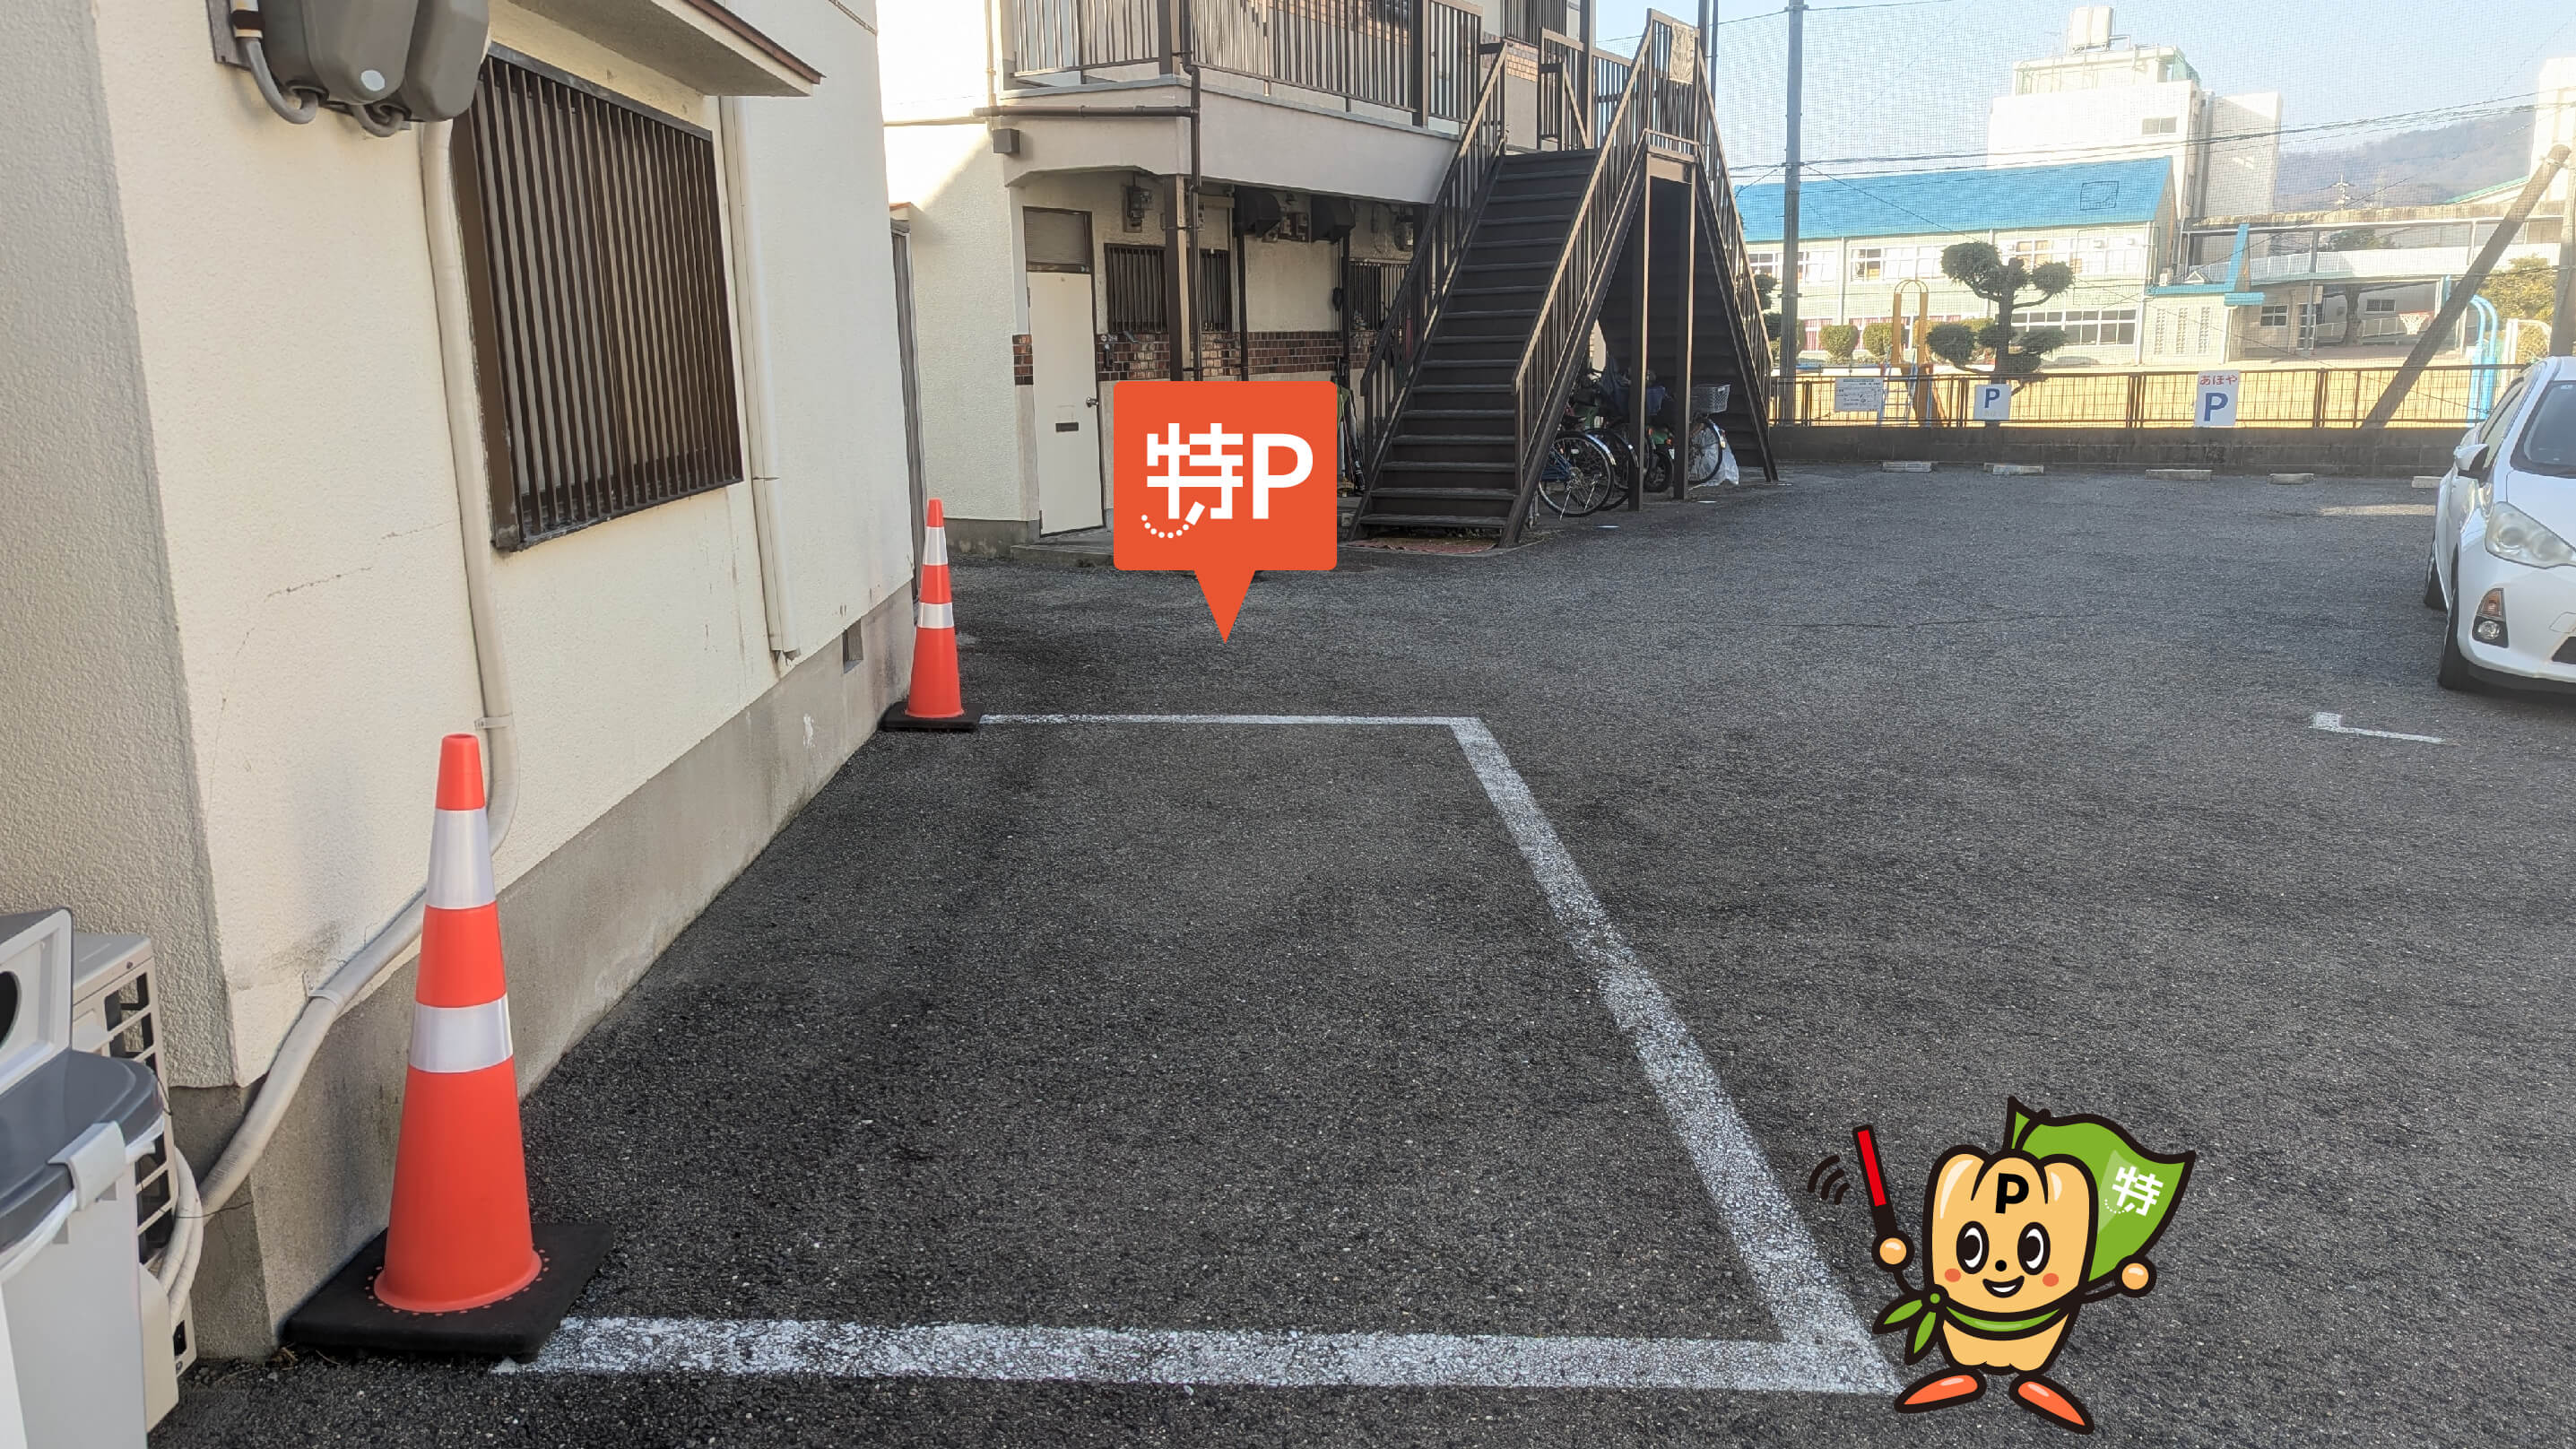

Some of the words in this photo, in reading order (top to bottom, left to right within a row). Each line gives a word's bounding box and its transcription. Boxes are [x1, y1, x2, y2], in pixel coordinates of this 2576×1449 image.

[2199, 375, 2237, 385] あほや
[1984, 388, 1999, 408] P
[2204, 393, 2228, 421] P
